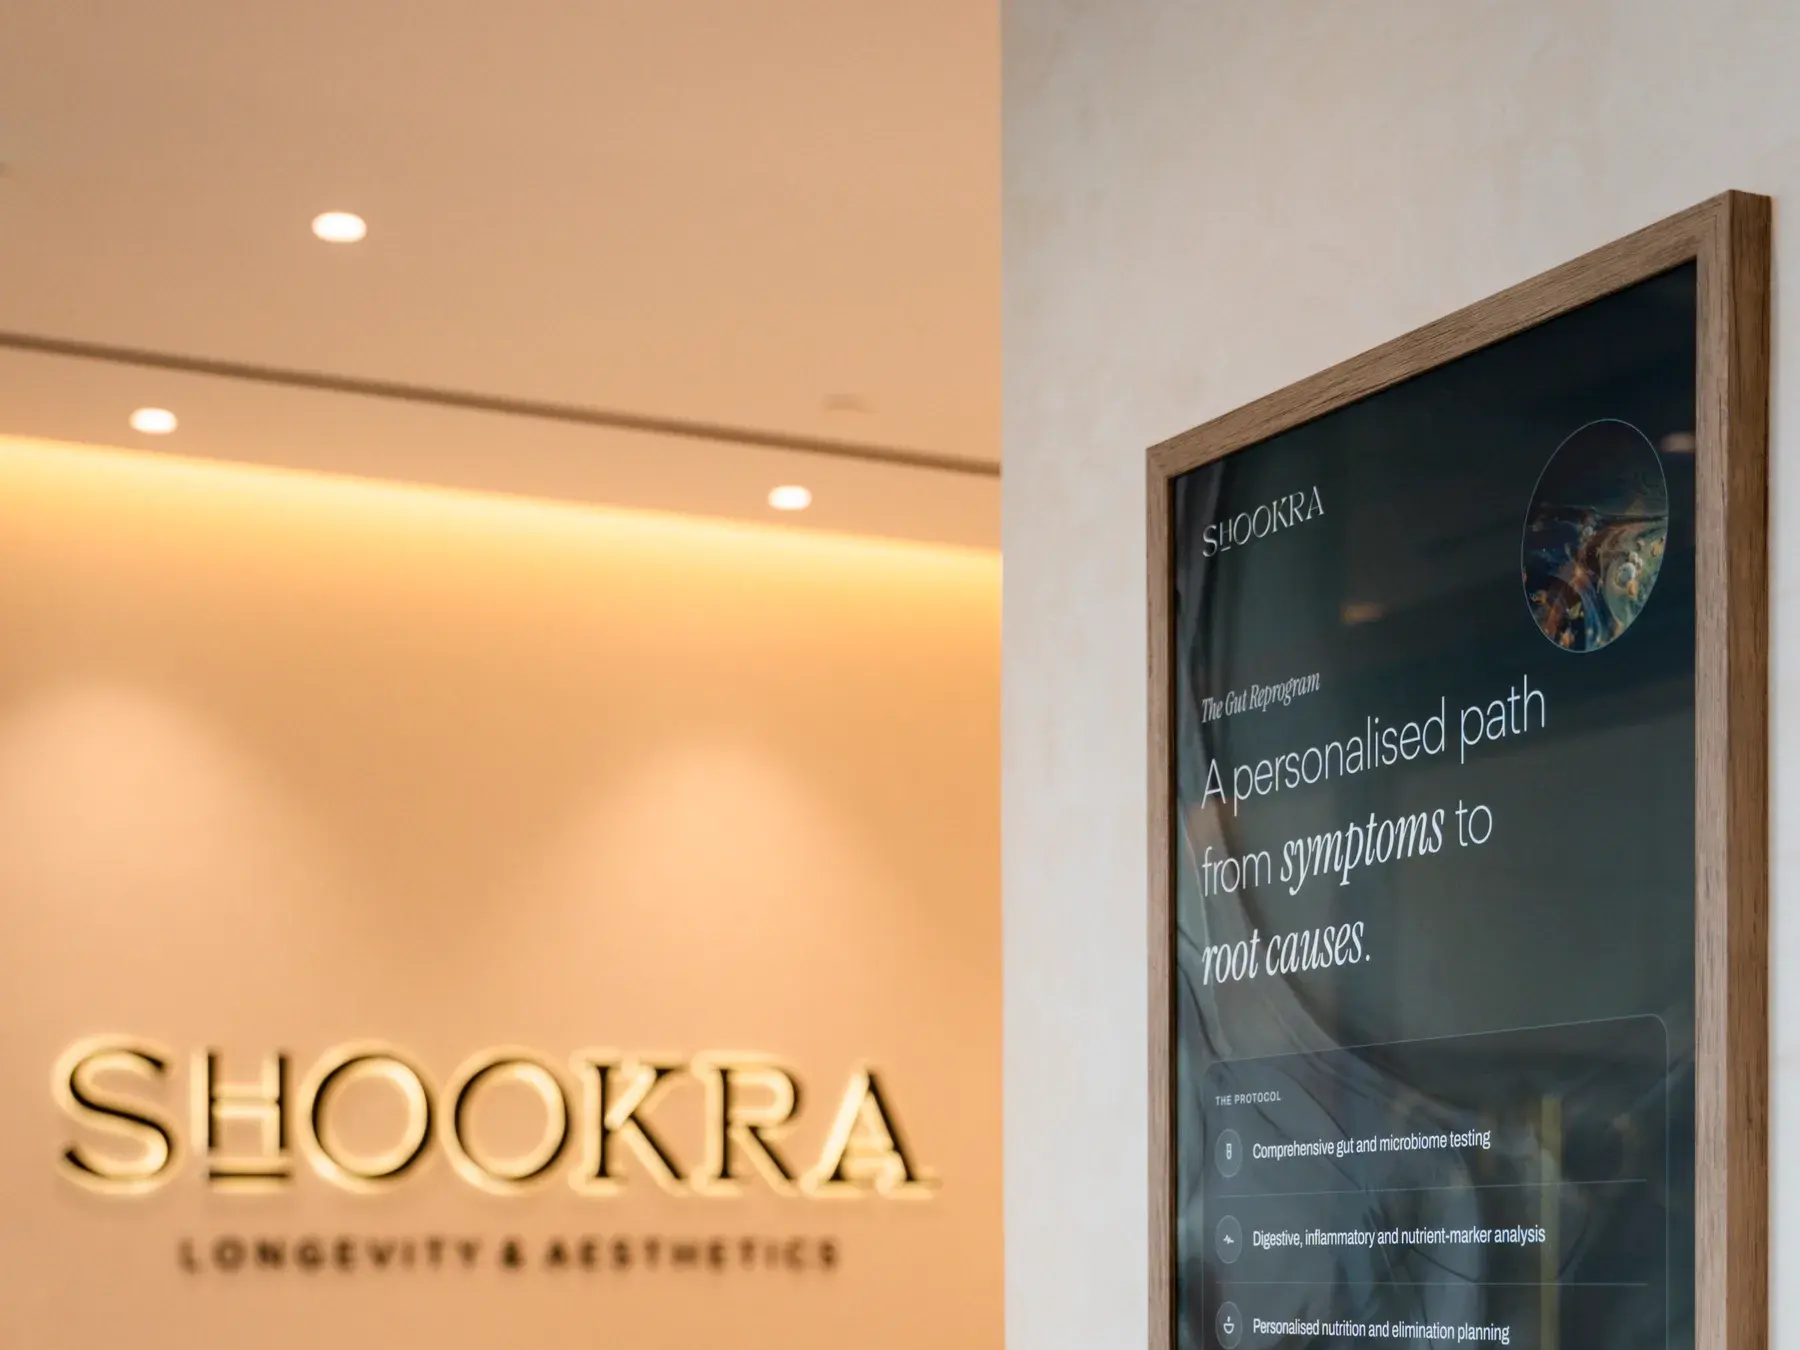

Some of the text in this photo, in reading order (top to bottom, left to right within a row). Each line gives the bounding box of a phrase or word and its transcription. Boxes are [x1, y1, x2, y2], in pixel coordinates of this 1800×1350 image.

[1203, 486, 1324, 558] SHOOKRA
[1202, 671, 1321, 723] The Gut Reprogram
[1202, 674, 1545, 817] A personalised path
[1202, 800, 1492, 897] from symptoms to
[1202, 921, 1370, 985] root causes.
[56, 1038, 934, 1190] SHOOKRA
[1216, 1090, 1281, 1106] THE PROTOCOL
[1252, 1130, 1491, 1161] Comprehensive gut and microbiome testing
[178, 1235, 842, 1274] LONGEVITY & AESTHETICS
[1252, 1224, 1545, 1252] Digestive, inflammatory and nutrient-marker analysis
[1252, 1318, 1510, 1345] Personalised nutrition and elimination planning
